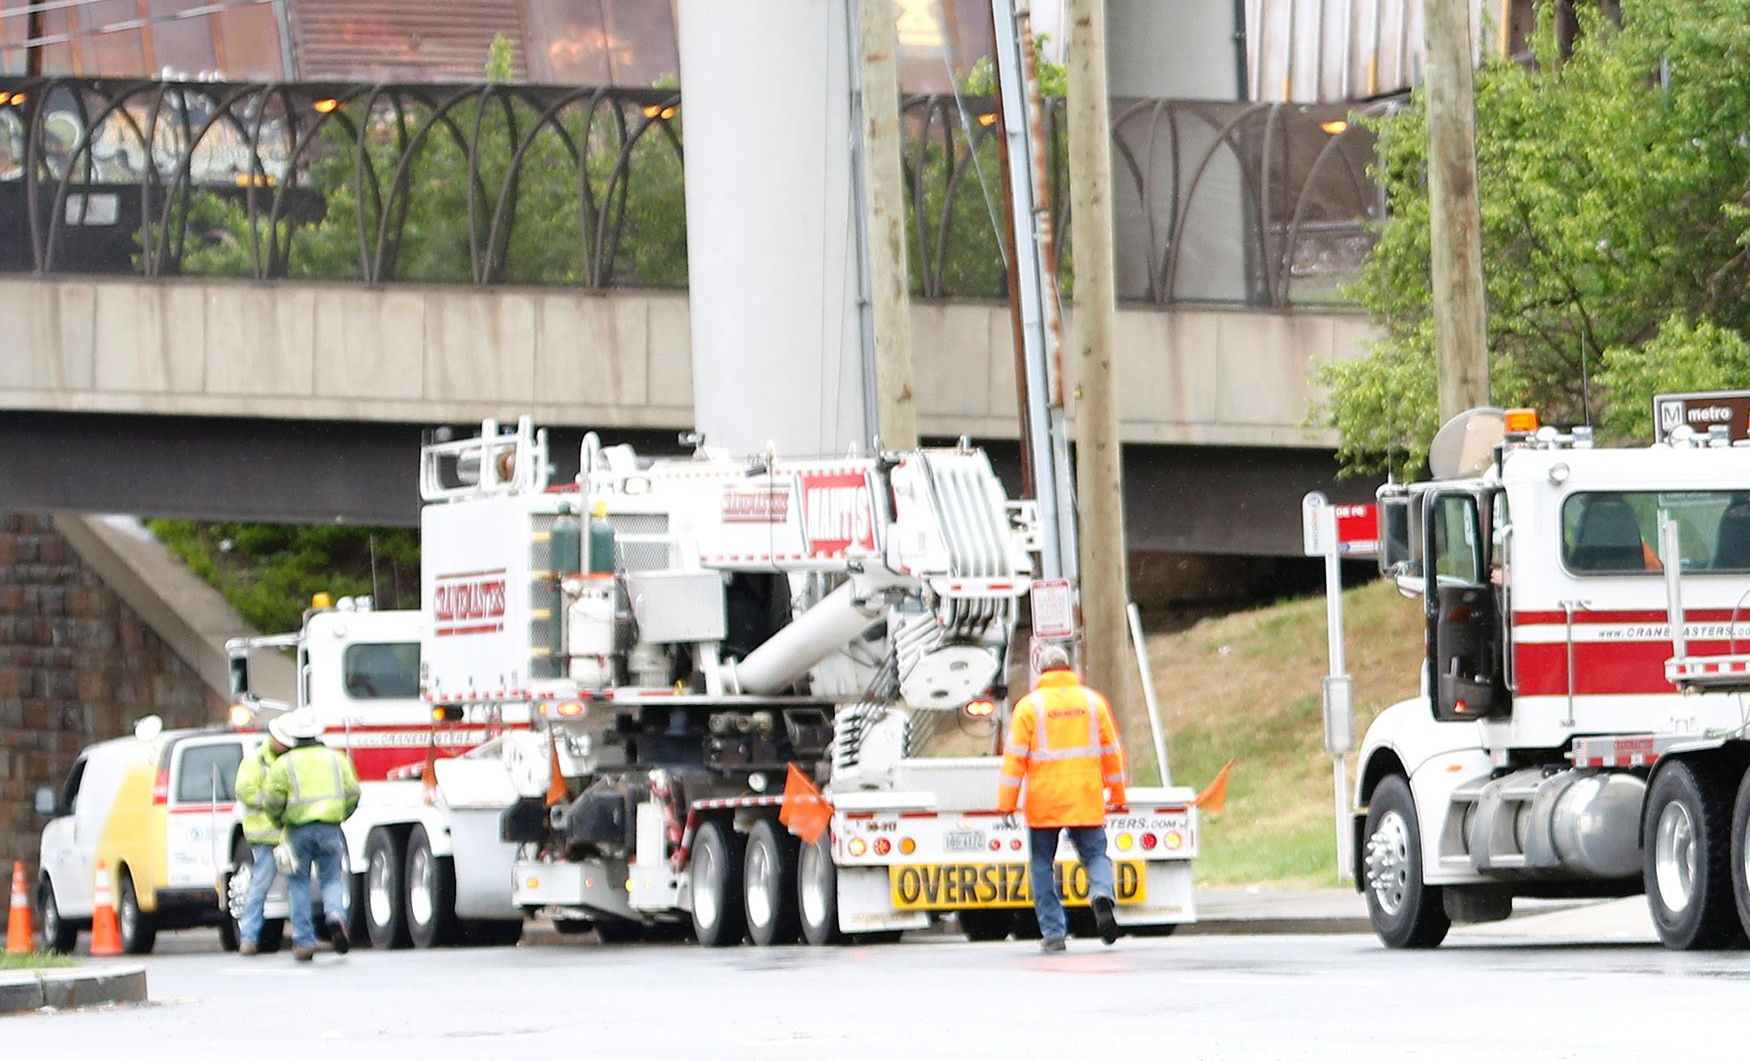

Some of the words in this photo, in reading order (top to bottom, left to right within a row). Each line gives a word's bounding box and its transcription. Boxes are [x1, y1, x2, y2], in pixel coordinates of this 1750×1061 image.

[1687, 406, 1732, 423] metro
[807, 486, 869, 543] MANTIS
[897, 864, 1032, 904] OVERSIZ
[1055, 862, 1138, 900] LOD
